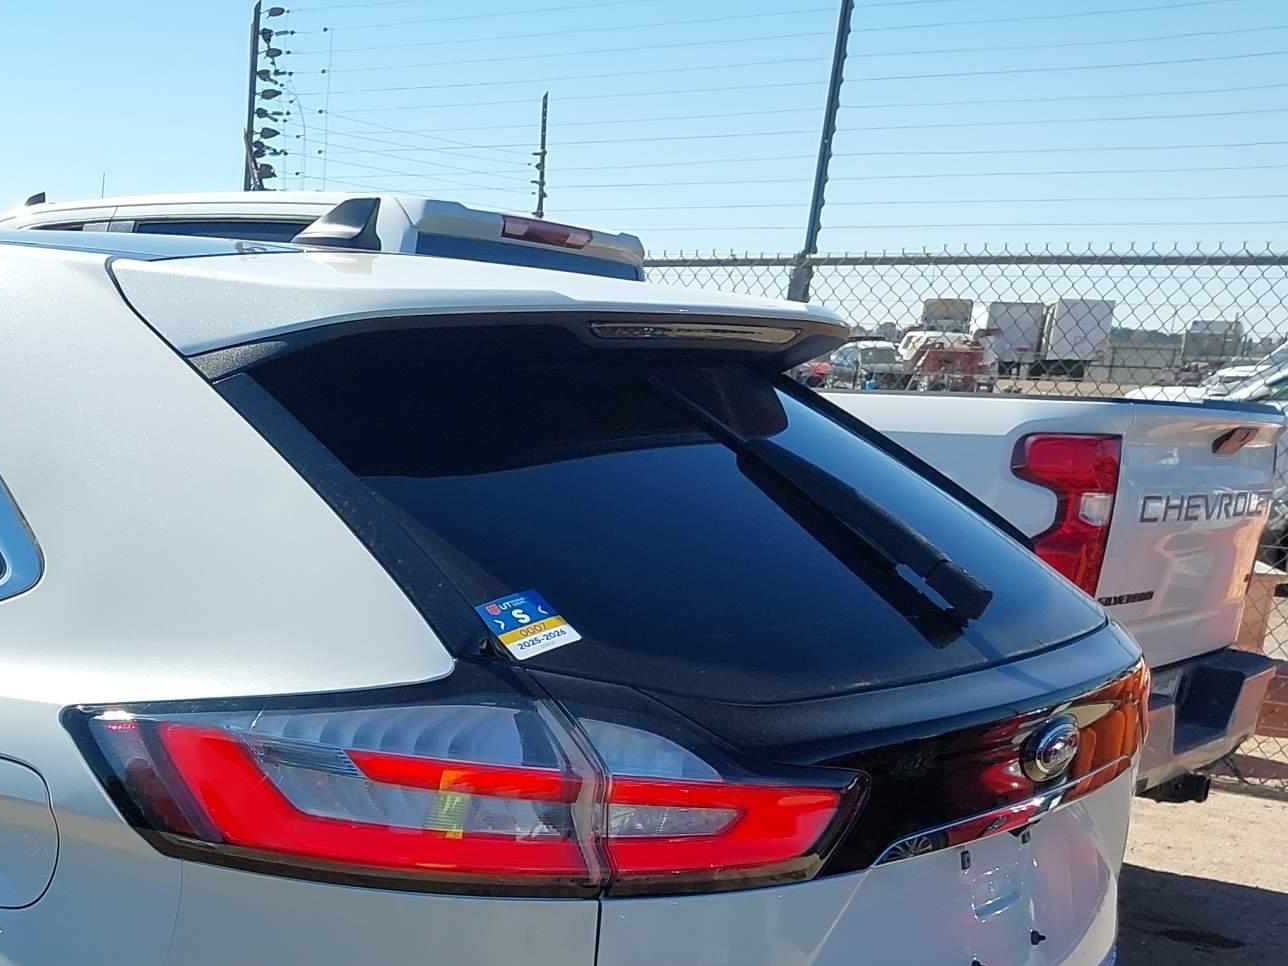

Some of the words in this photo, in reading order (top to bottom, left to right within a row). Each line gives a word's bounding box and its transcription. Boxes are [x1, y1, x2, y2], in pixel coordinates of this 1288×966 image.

[511, 608, 531, 624] S
[519, 622, 546, 637] 0007
[517, 628, 567, 650] 2025-2026
